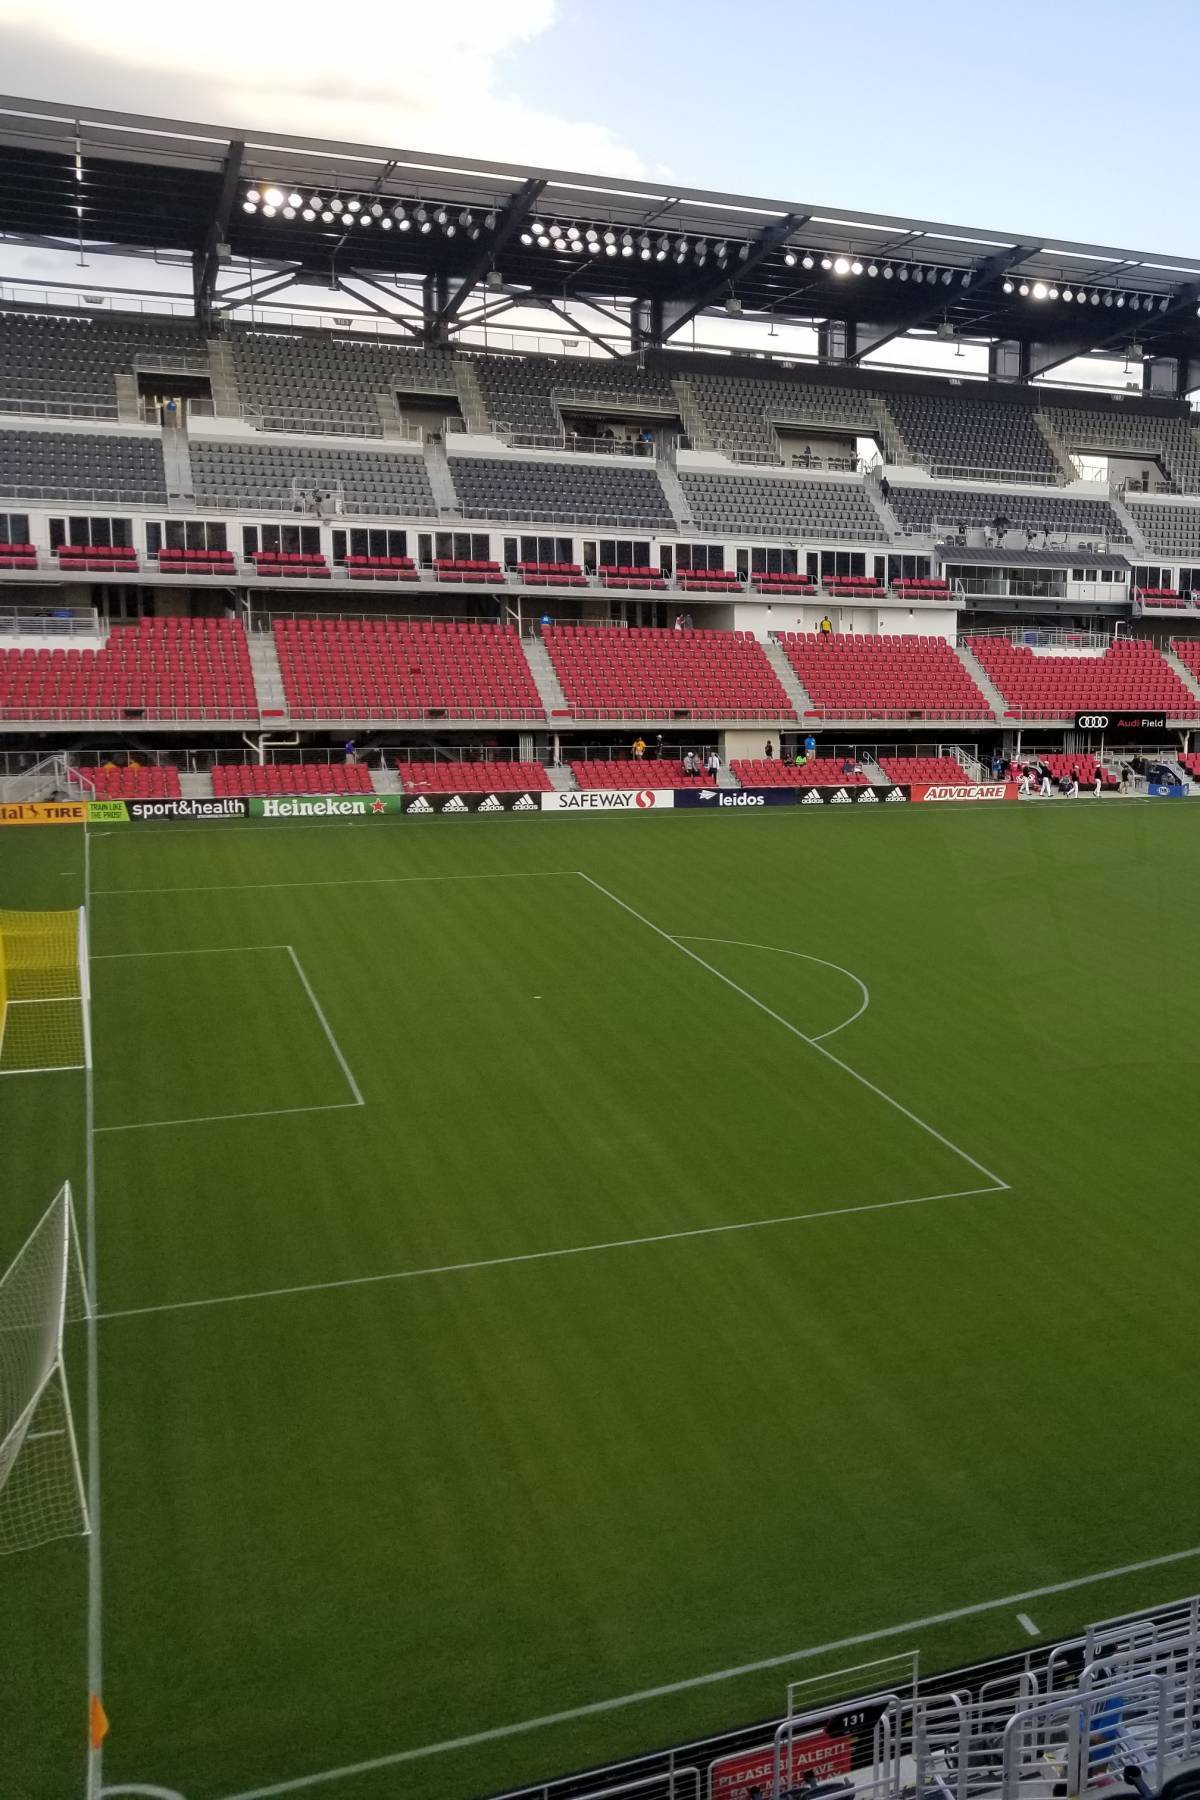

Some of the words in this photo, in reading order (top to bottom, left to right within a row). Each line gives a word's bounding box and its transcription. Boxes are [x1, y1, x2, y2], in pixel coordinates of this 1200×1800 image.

[1117, 718, 1140, 728] Audi
[1141, 718, 1164, 728] Field
[719, 793, 765, 807] leidos
[925, 785, 1005, 800] ADVOCARE
[262, 798, 367, 817] Heineken
[559, 793, 634, 808] SAFEWAY
[43, 807, 83, 818] TIRE
[132, 799, 245, 819] sport&health
[842, 1712, 865, 1727] 131
[719, 1763, 773, 1787] PLEASE
[797, 1743, 846, 1766] ALERT!
